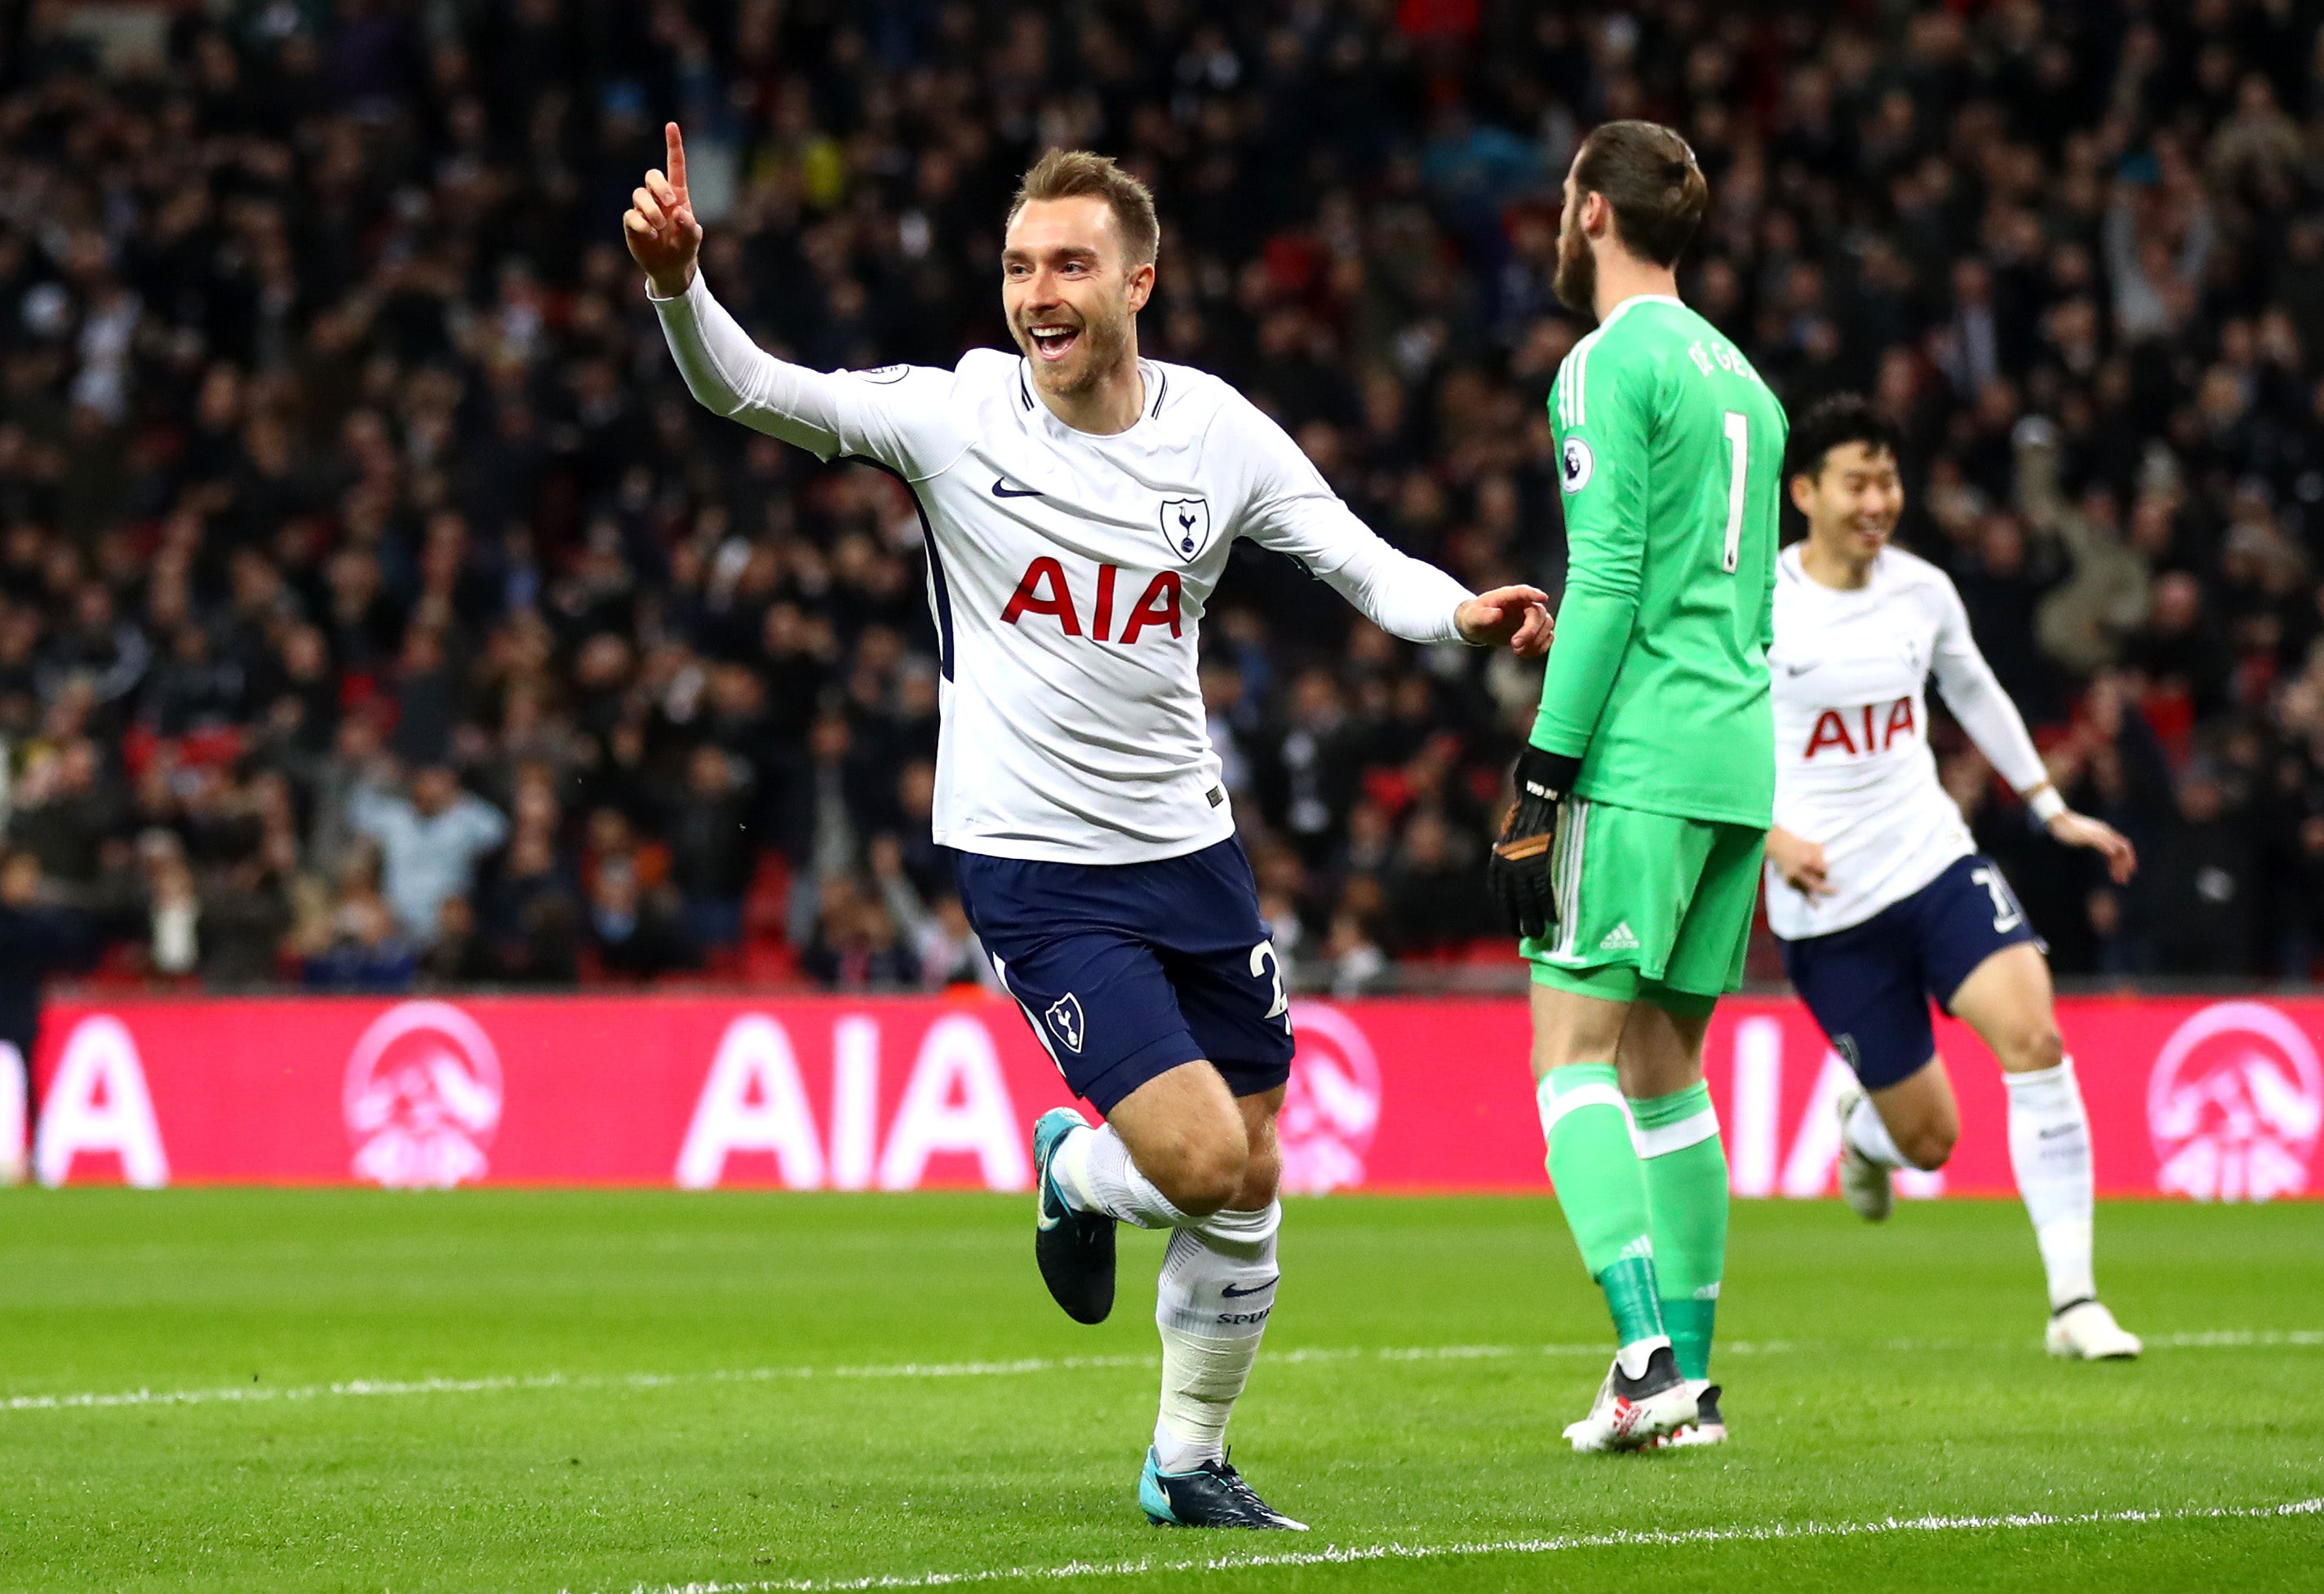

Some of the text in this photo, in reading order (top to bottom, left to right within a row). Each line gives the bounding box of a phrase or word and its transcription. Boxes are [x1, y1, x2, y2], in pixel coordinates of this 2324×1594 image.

[1723, 410, 1750, 574] 1
[1000, 556, 1182, 644] AIA
[1804, 695, 1916, 759] AIA
[1249, 935, 1291, 1035] 2
[676, 1012, 1033, 1191] AIA
